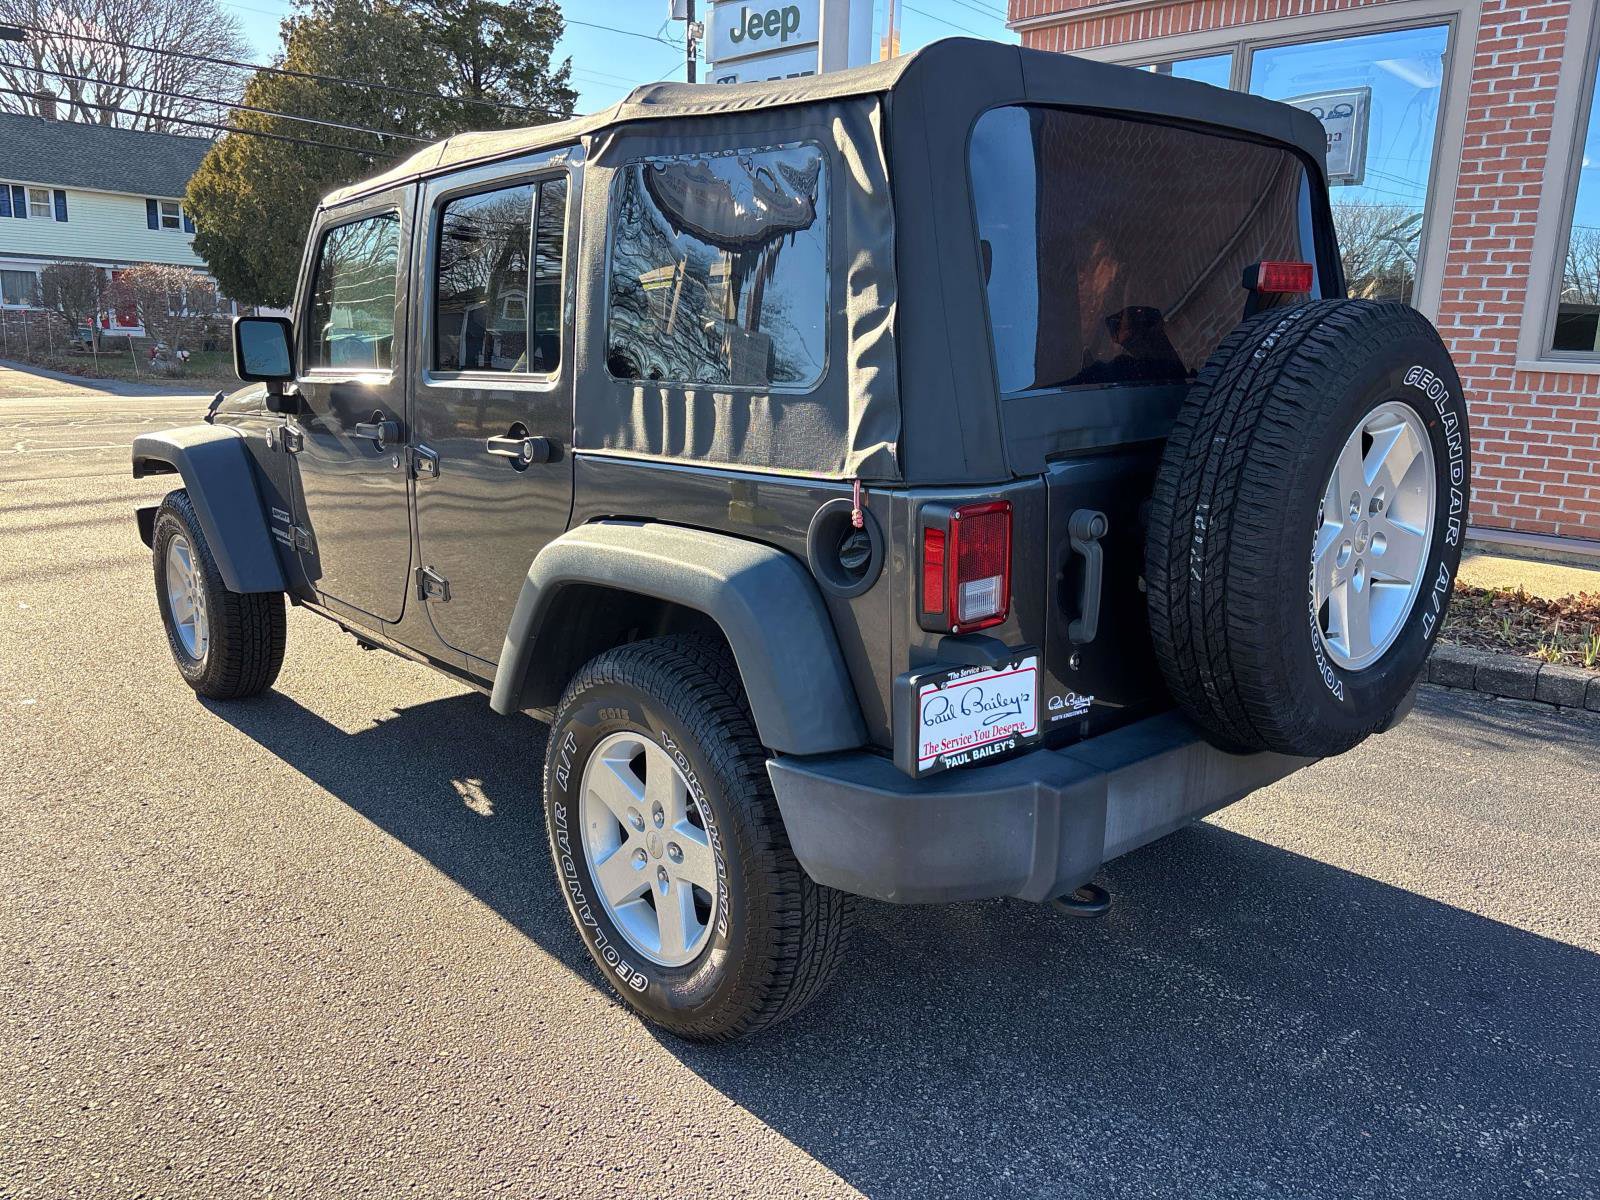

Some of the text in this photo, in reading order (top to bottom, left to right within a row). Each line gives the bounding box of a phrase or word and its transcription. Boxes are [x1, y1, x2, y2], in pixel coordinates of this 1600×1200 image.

[730, 5, 800, 43] Jeep
[1403, 365, 1464, 640] GEOLANDAR A/T
[923, 686, 1031, 727] Paul Bailey's
[923, 720, 1028, 757] The Service You Deserve.
[945, 739, 1015, 769] PAUL BAILEY'S
[661, 730, 729, 939] YOKOHAMA
[554, 731, 649, 993] GEOLANDAR A/T
